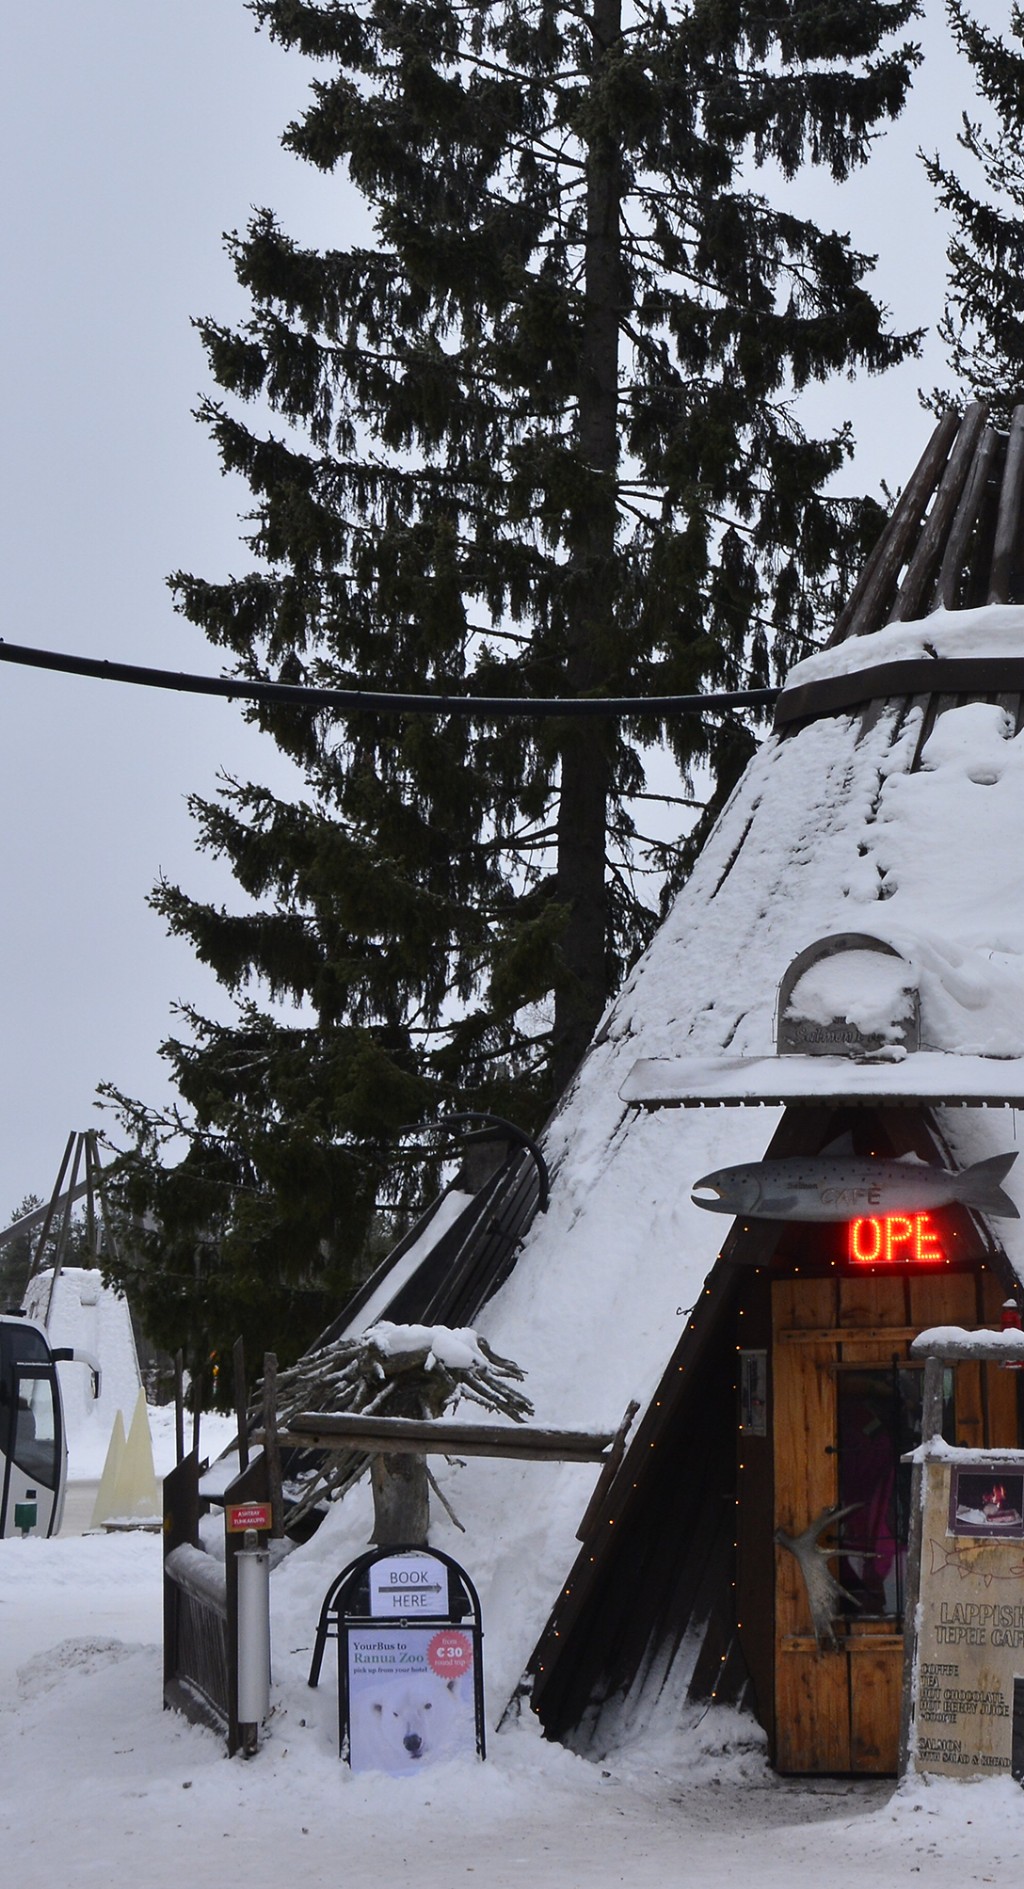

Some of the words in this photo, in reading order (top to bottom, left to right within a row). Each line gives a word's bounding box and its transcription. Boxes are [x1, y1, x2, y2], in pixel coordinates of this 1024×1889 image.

[390, 1571, 429, 1584] BOOK
[392, 1594, 427, 1607] HERE
[934, 1625, 986, 1646] TEPEE
[353, 1642, 396, 1651] YourBus
[397, 1643, 407, 1651] to
[447, 1647, 463, 1658] 30
[354, 1653, 395, 1663] Ranua
[400, 1652, 424, 1663] Zoo
[920, 1663, 959, 1676] COFFEE
[920, 1675, 940, 1687] TEA
[921, 1688, 941, 1699] HOT
[943, 1689, 1005, 1704] CHOCOLATE
[919, 1700, 941, 1711] HOT
[943, 1701, 978, 1714] BERRY
[980, 1703, 1010, 1717] JUICE
[918, 1738, 962, 1752] SALMON
[942, 1752, 970, 1764] SALAD
